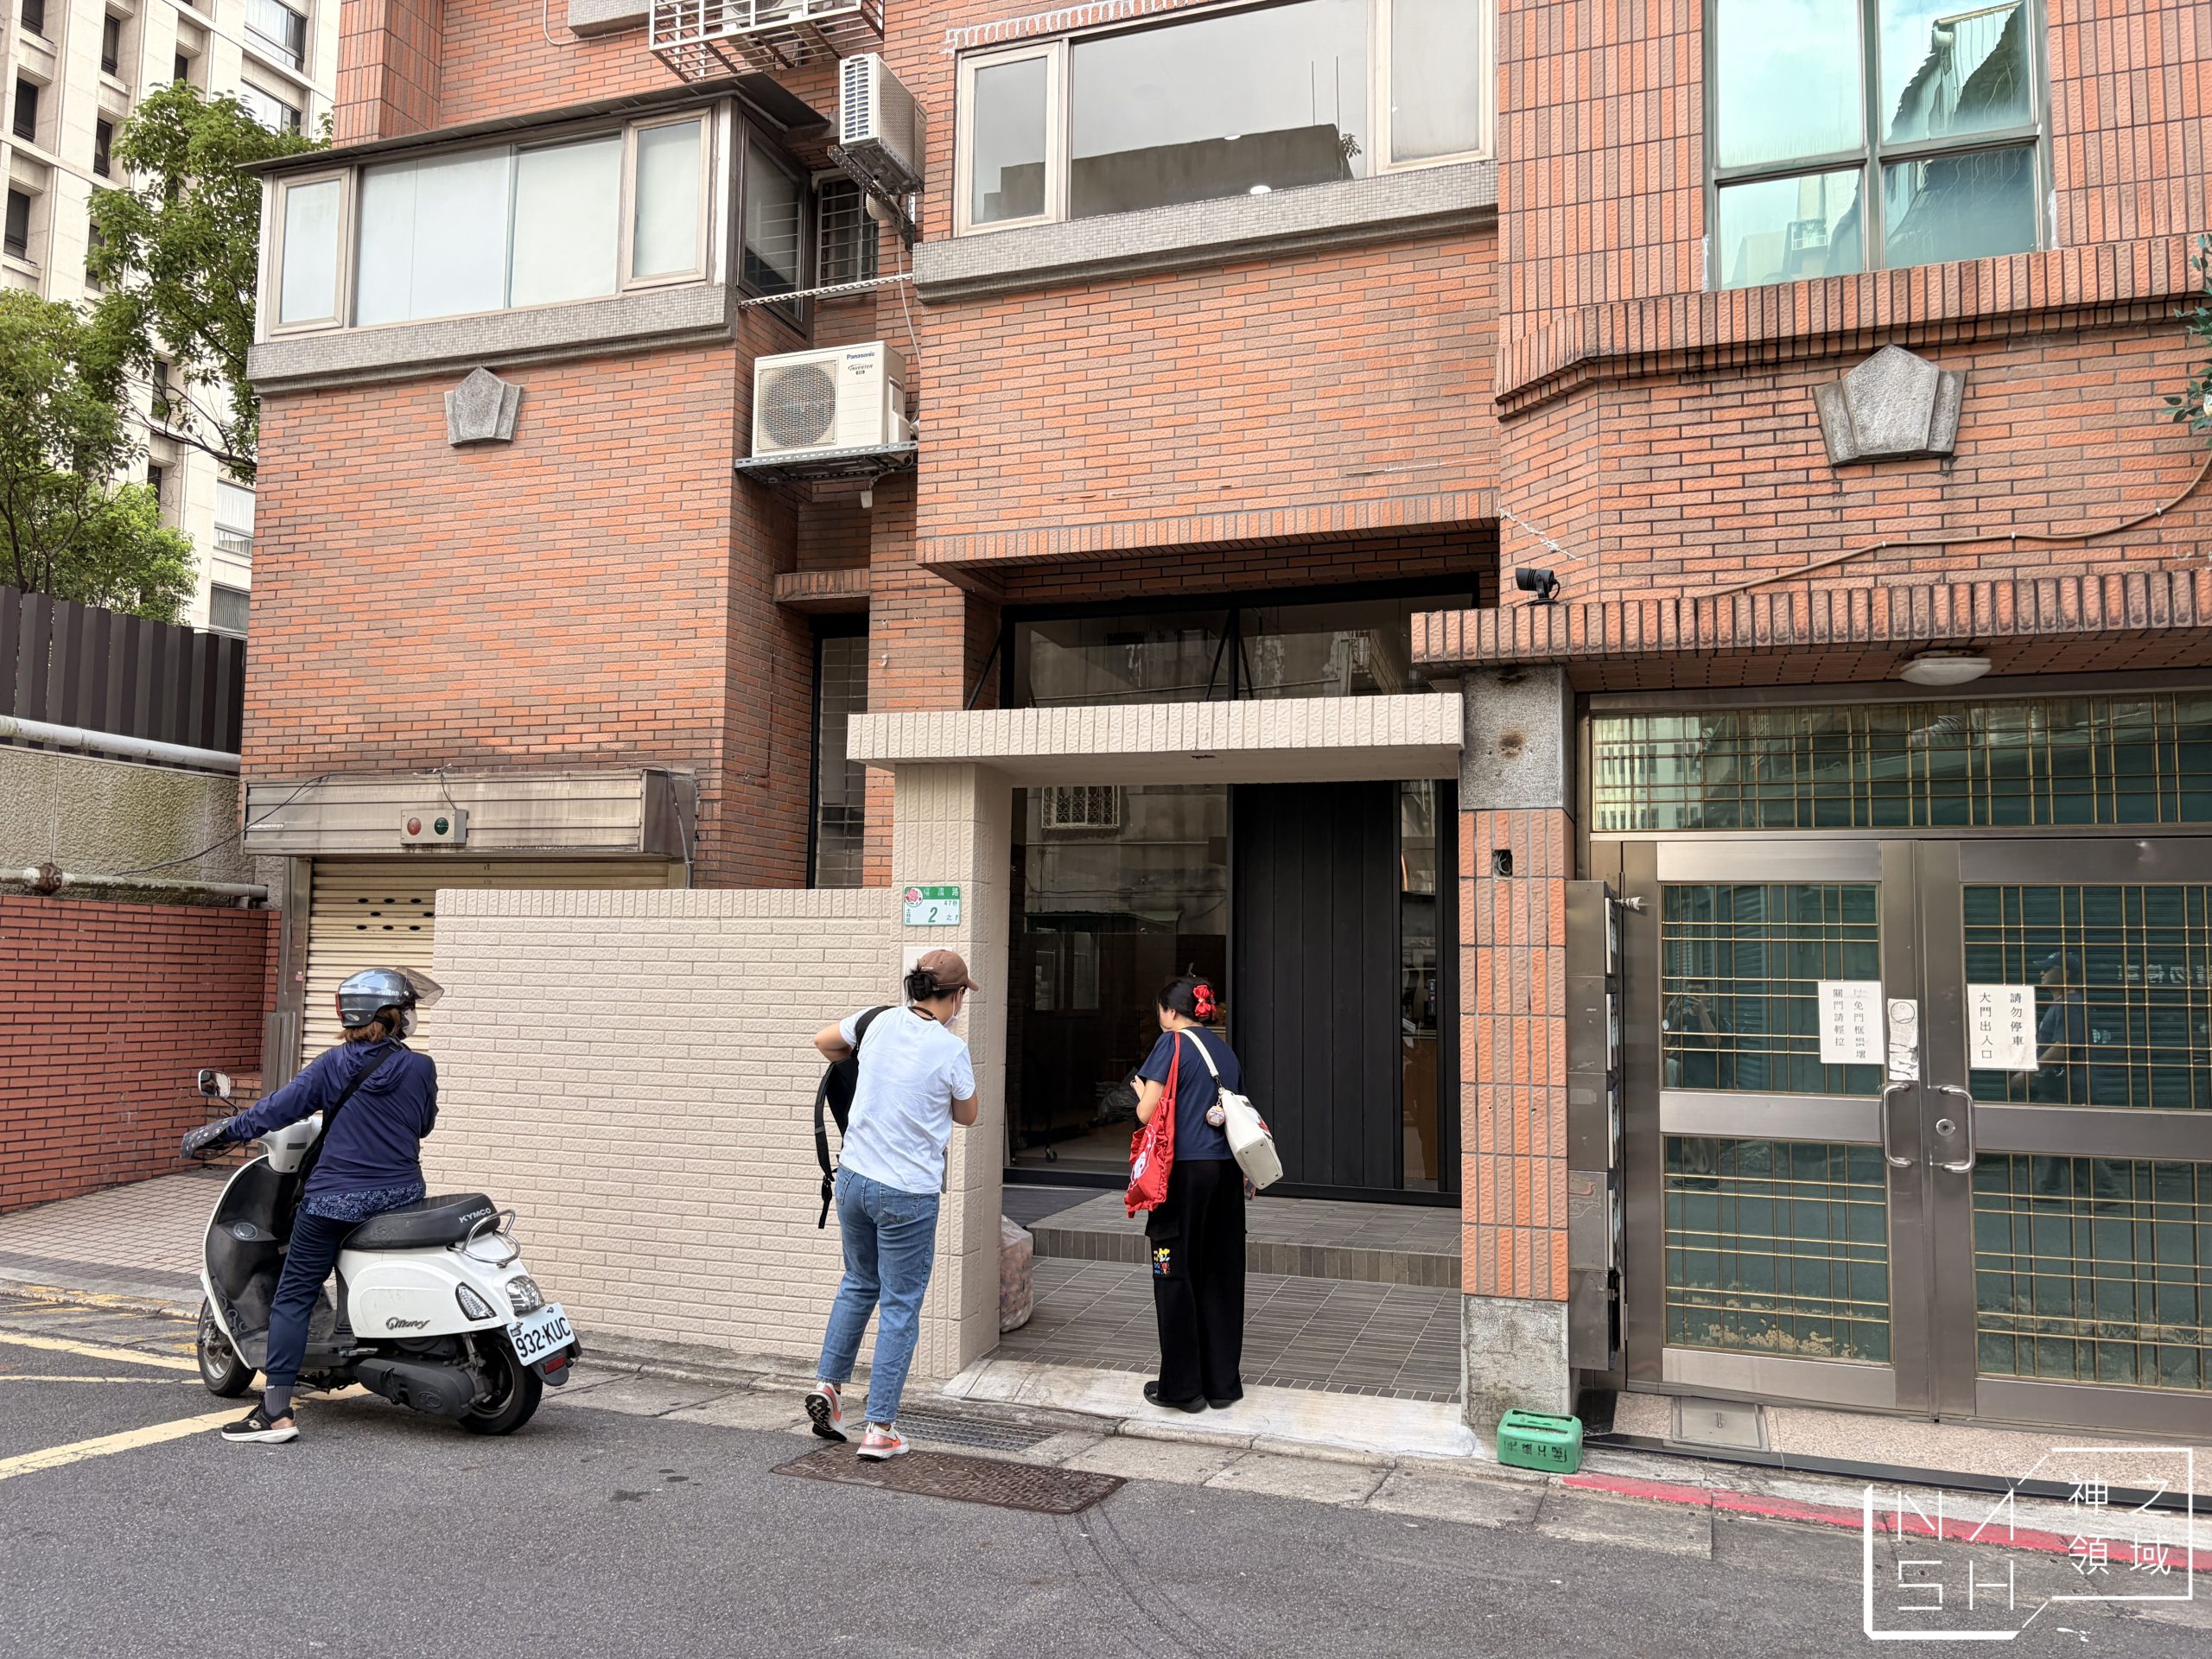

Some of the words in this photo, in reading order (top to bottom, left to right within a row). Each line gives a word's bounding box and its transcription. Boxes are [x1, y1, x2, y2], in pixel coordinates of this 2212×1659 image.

[847, 351, 875, 359] Panasonic
[928, 906, 938, 923] 2
[1833, 988, 1845, 1046] 關門請輕拉
[1980, 992, 1993, 1058] 大門出入口
[2010, 993, 2024, 1047] 請勿停車
[459, 1207, 492, 1224] KYMCO
